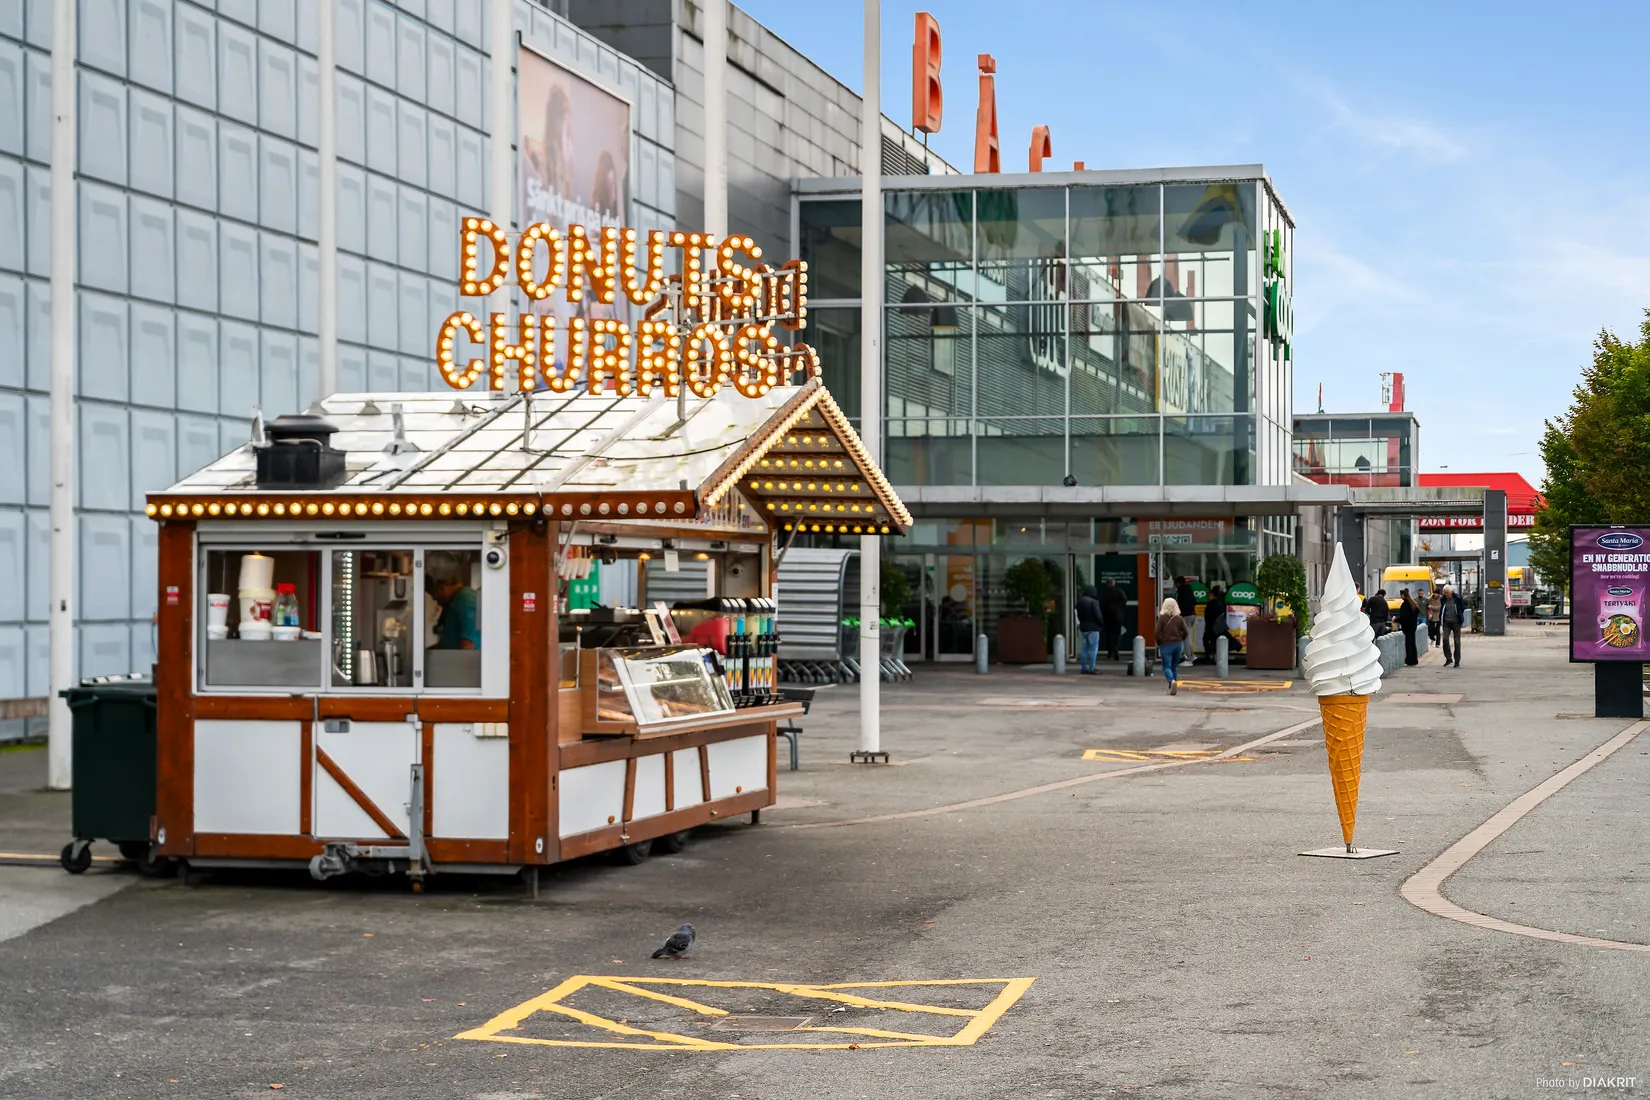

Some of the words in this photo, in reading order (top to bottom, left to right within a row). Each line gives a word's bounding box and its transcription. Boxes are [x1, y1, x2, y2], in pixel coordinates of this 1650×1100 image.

[460, 216, 762, 309] DONUTS
[436, 310, 777, 399] CHURROS
[1583, 554, 1594, 563] EN
[1595, 554, 1606, 563] NY
[1608, 554, 1650, 563] GENERATIO
[1592, 563, 1648, 572] SNABBNUDLAR
[1232, 590, 1256, 599] coop
